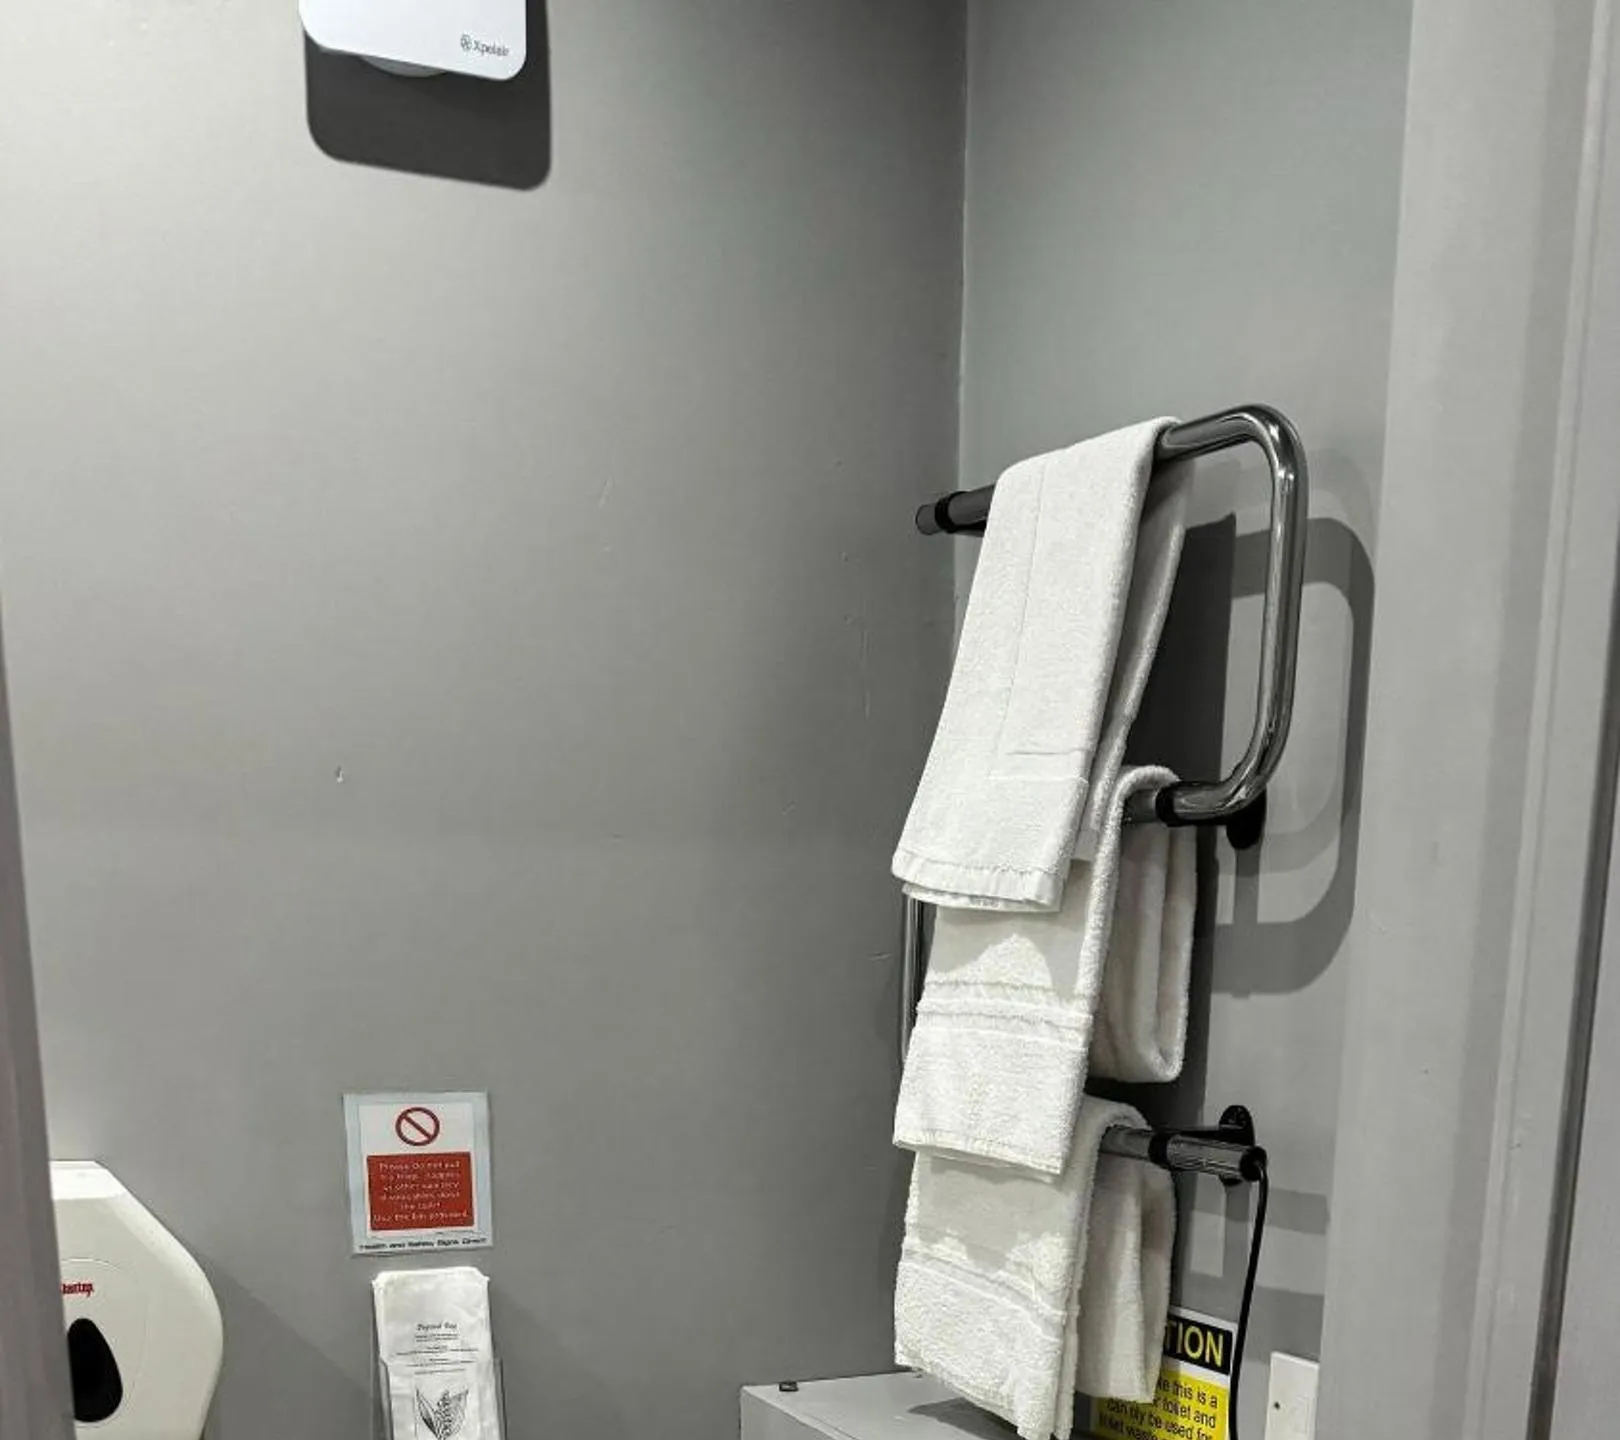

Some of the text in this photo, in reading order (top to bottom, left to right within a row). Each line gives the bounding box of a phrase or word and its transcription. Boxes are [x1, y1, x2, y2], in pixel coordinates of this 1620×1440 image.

[1164, 1320, 1224, 1367] TION
[1197, 1388, 1206, 1405] is
[1209, 1395, 1218, 1409] a
[1193, 1410, 1216, 1429] and
